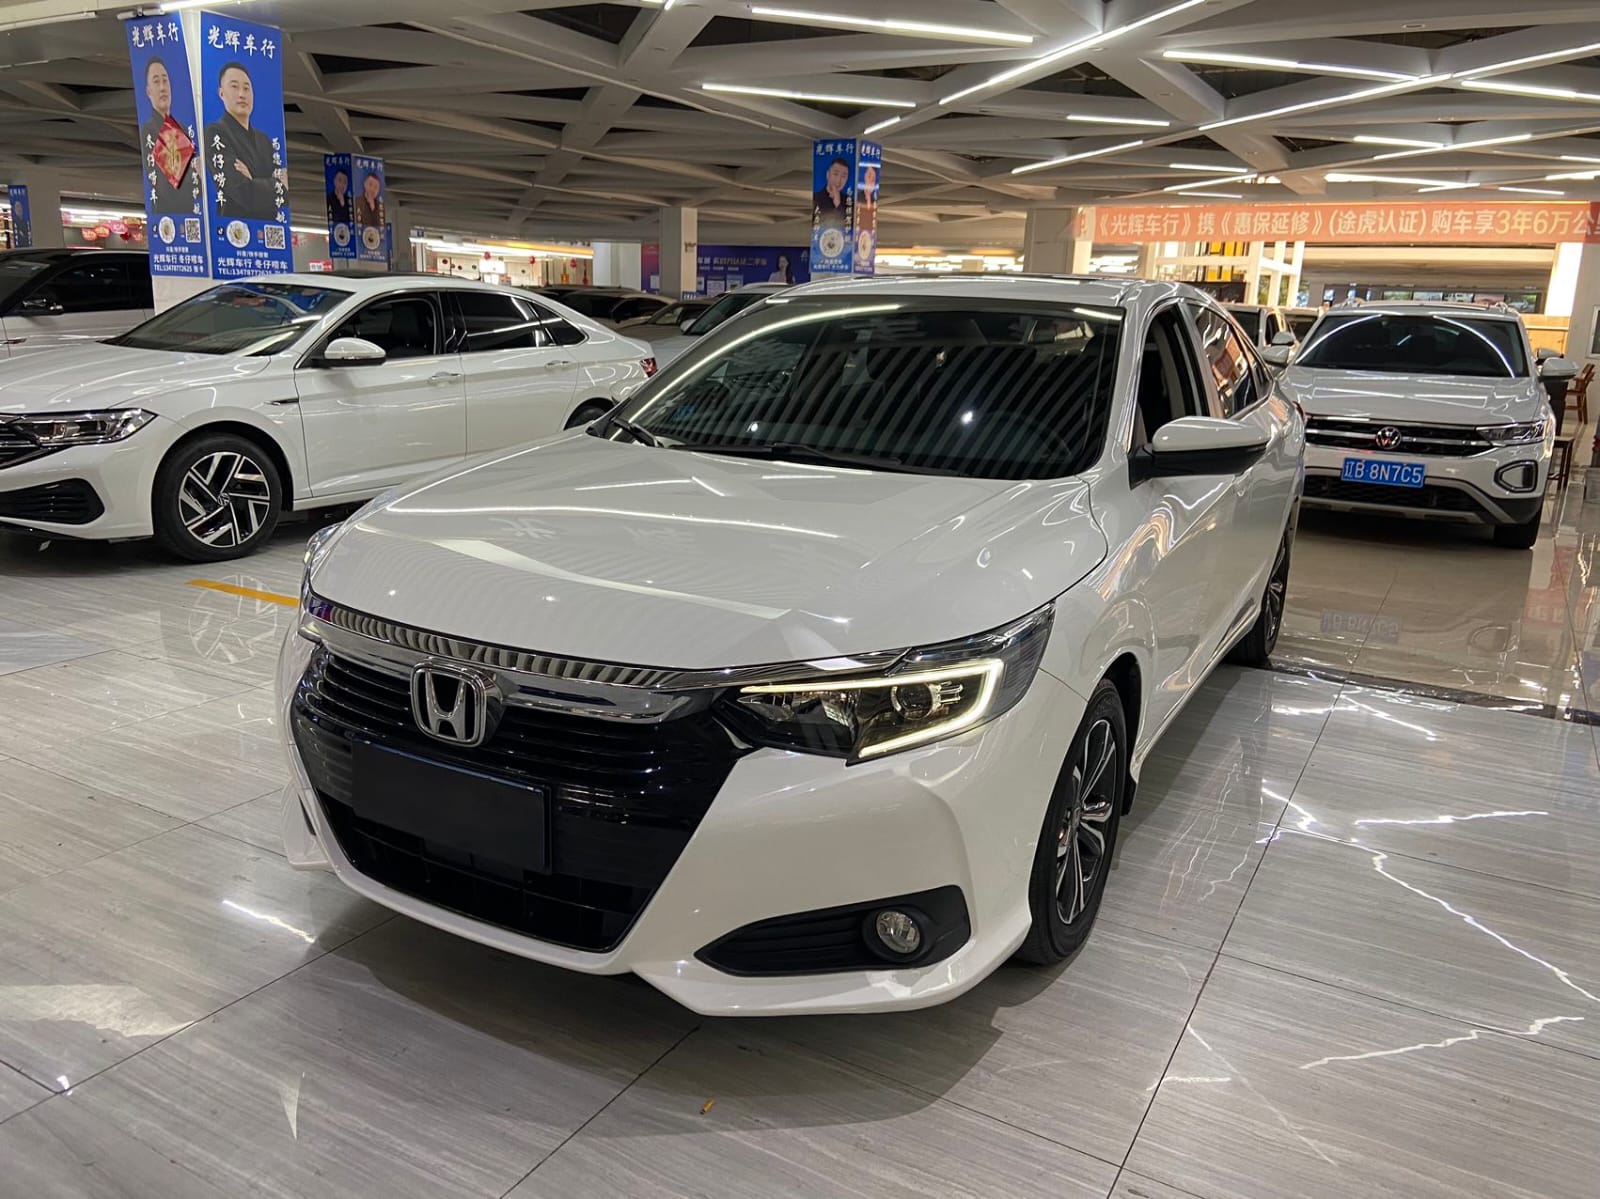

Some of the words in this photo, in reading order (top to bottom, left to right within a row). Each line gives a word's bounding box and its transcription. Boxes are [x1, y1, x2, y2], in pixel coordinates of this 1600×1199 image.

[132, 22, 178, 48] 光辉车行
[207, 24, 276, 59] 光辉车行
